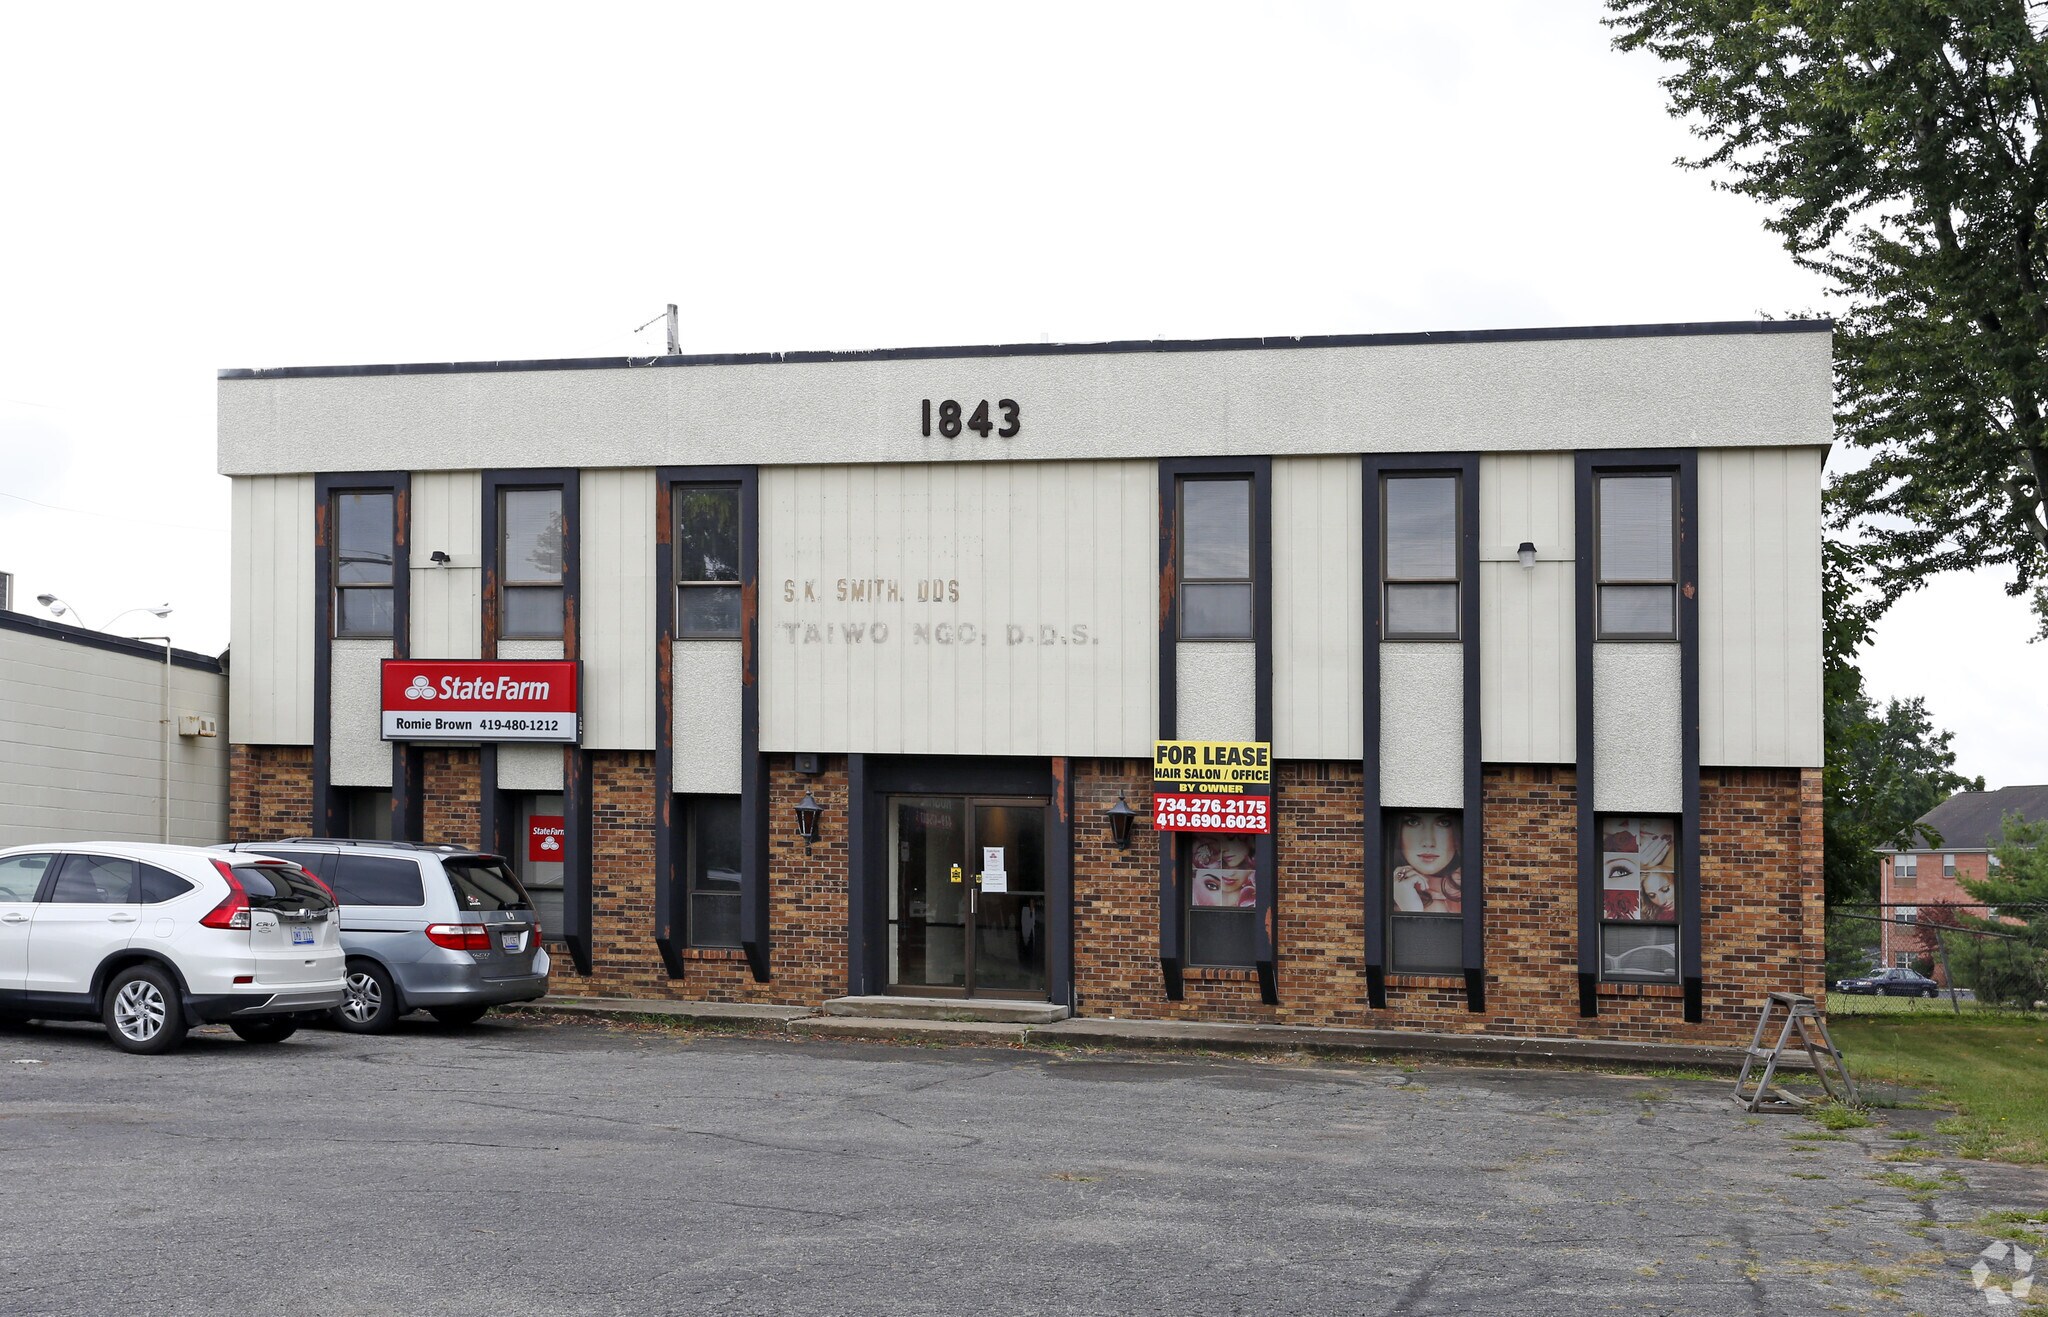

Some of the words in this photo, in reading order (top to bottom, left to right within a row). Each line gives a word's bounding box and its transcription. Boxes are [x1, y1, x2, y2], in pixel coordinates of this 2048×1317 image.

[922, 398, 1021, 438] 1843
[917, 579, 960, 602] DDS
[782, 622, 889, 645] TAIWO
[396, 717, 431, 731] Romie
[435, 718, 472, 731] Brown
[479, 719, 559, 732] 419-480-1212
[1156, 745, 1197, 765] FOR
[1203, 746, 1268, 767] LEASE
[1155, 768, 1181, 779] HAIR
[1184, 769, 1221, 780] SALON
[1231, 769, 1269, 781] OFFICE
[1179, 783, 1195, 793] BY
[1199, 783, 1244, 794] OWNER
[1156, 798, 1267, 815] 734.276.2175
[1156, 813, 1267, 830] 419.690.6023
